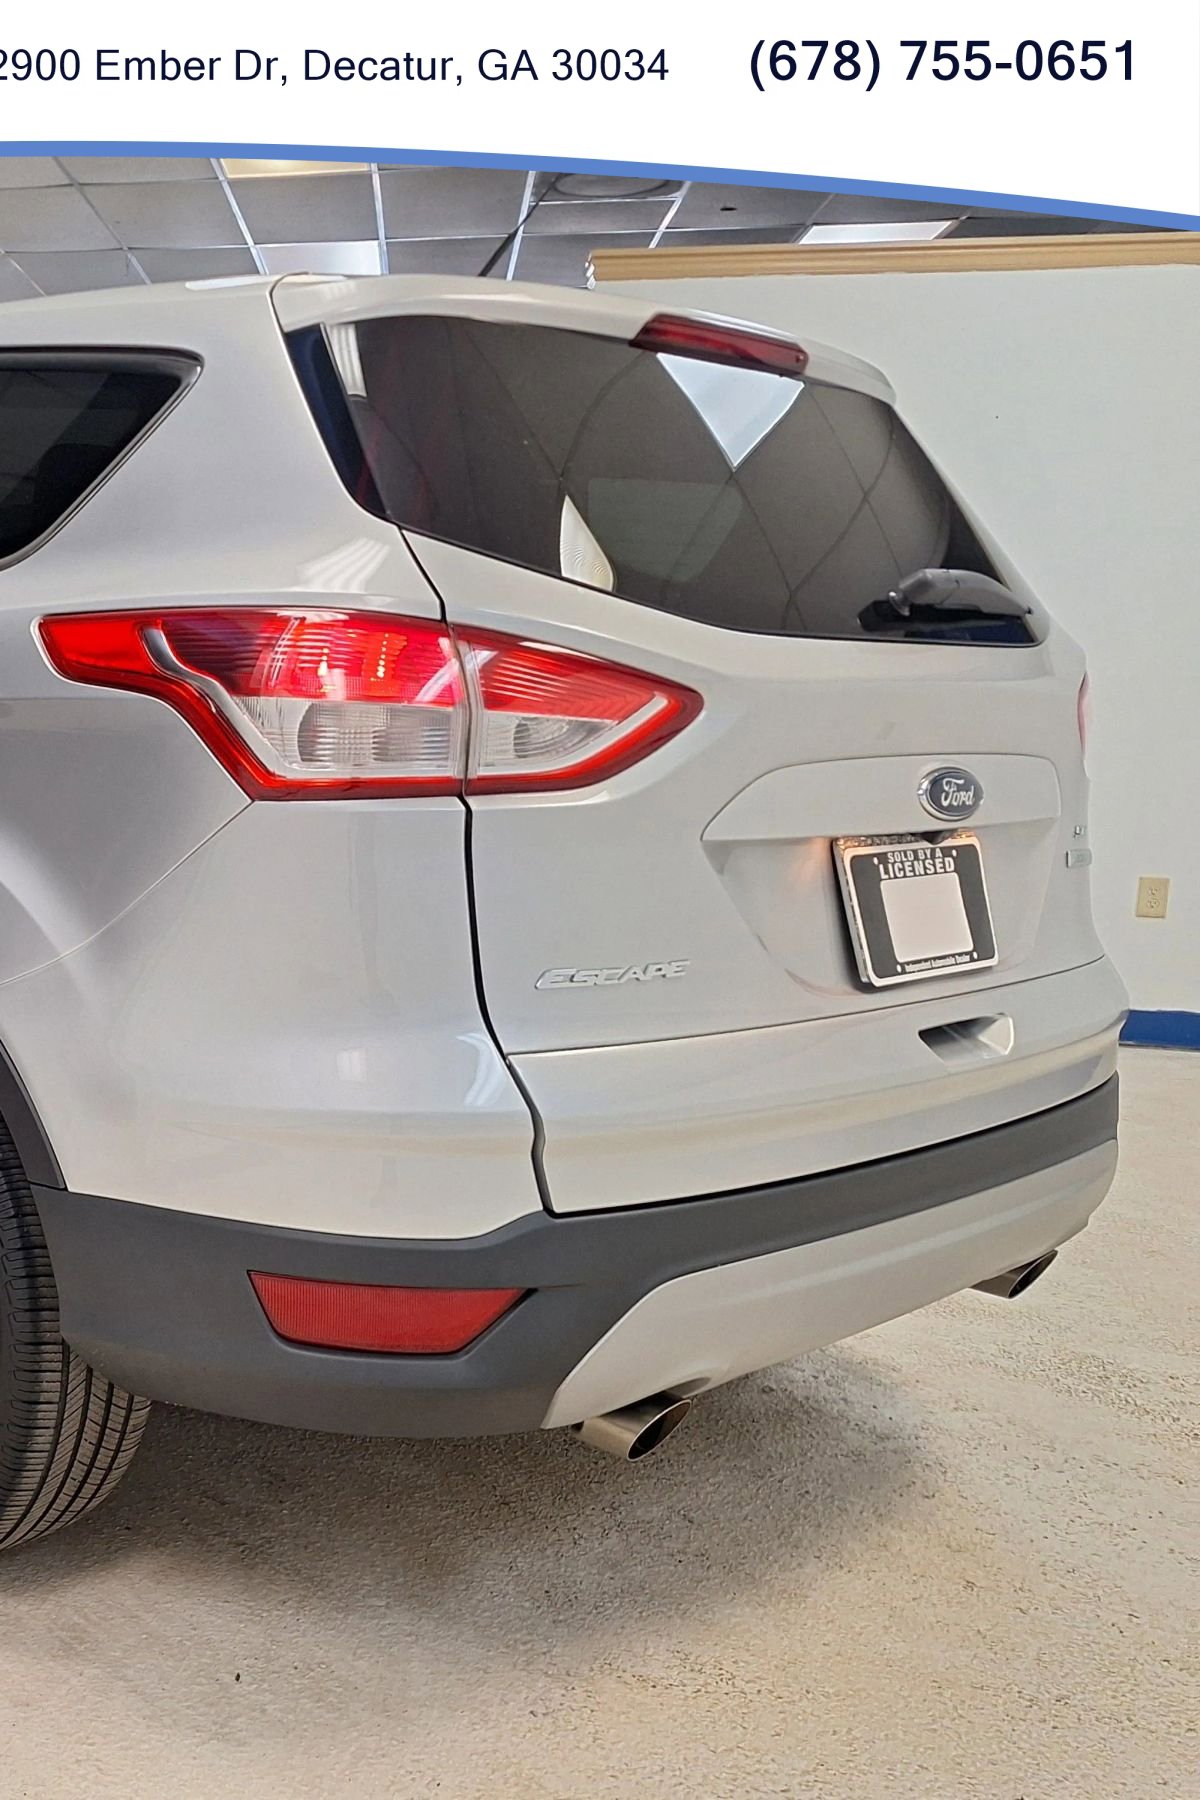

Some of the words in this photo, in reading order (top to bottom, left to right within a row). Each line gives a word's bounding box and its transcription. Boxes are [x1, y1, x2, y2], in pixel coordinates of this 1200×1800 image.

[941, 777, 975, 807] Ford
[879, 857, 955, 879] LICENSED
[887, 850, 914, 863] SOLD
[918, 848, 932, 860] BY
[935, 847, 943, 858] A
[534, 958, 692, 990] ESCAPE
